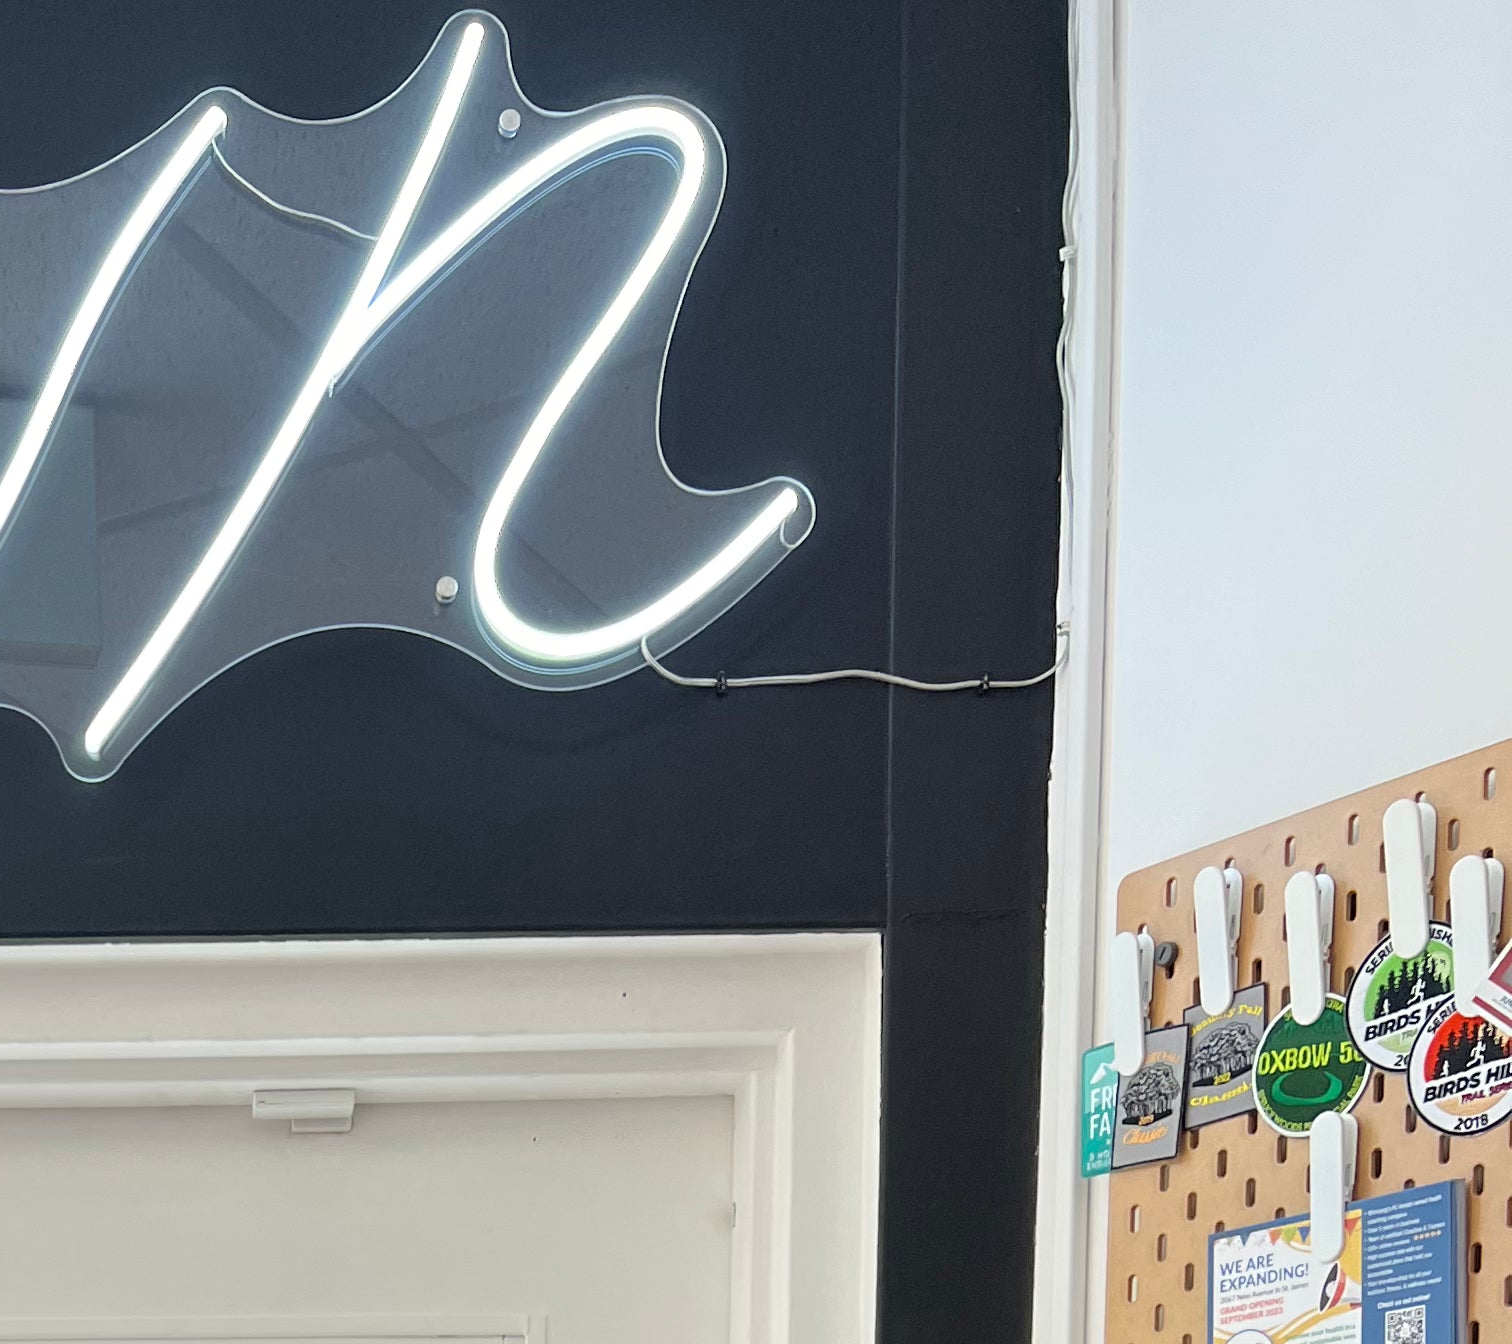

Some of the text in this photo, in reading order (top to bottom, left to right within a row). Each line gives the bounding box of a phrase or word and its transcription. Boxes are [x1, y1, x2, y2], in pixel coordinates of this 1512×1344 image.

[1364, 1009, 1421, 1042] BIRDS
[1427, 1001, 1457, 1034] SERIE
[1257, 1041, 1332, 1076] OXBOW
[1424, 1072, 1482, 1103] BIRDS
[1090, 1112, 1111, 1140] FA
[1453, 1114, 1489, 1131] 2018
[1220, 1253, 1274, 1276] WE ARE
[1220, 1263, 1309, 1293] EXPANDING!
